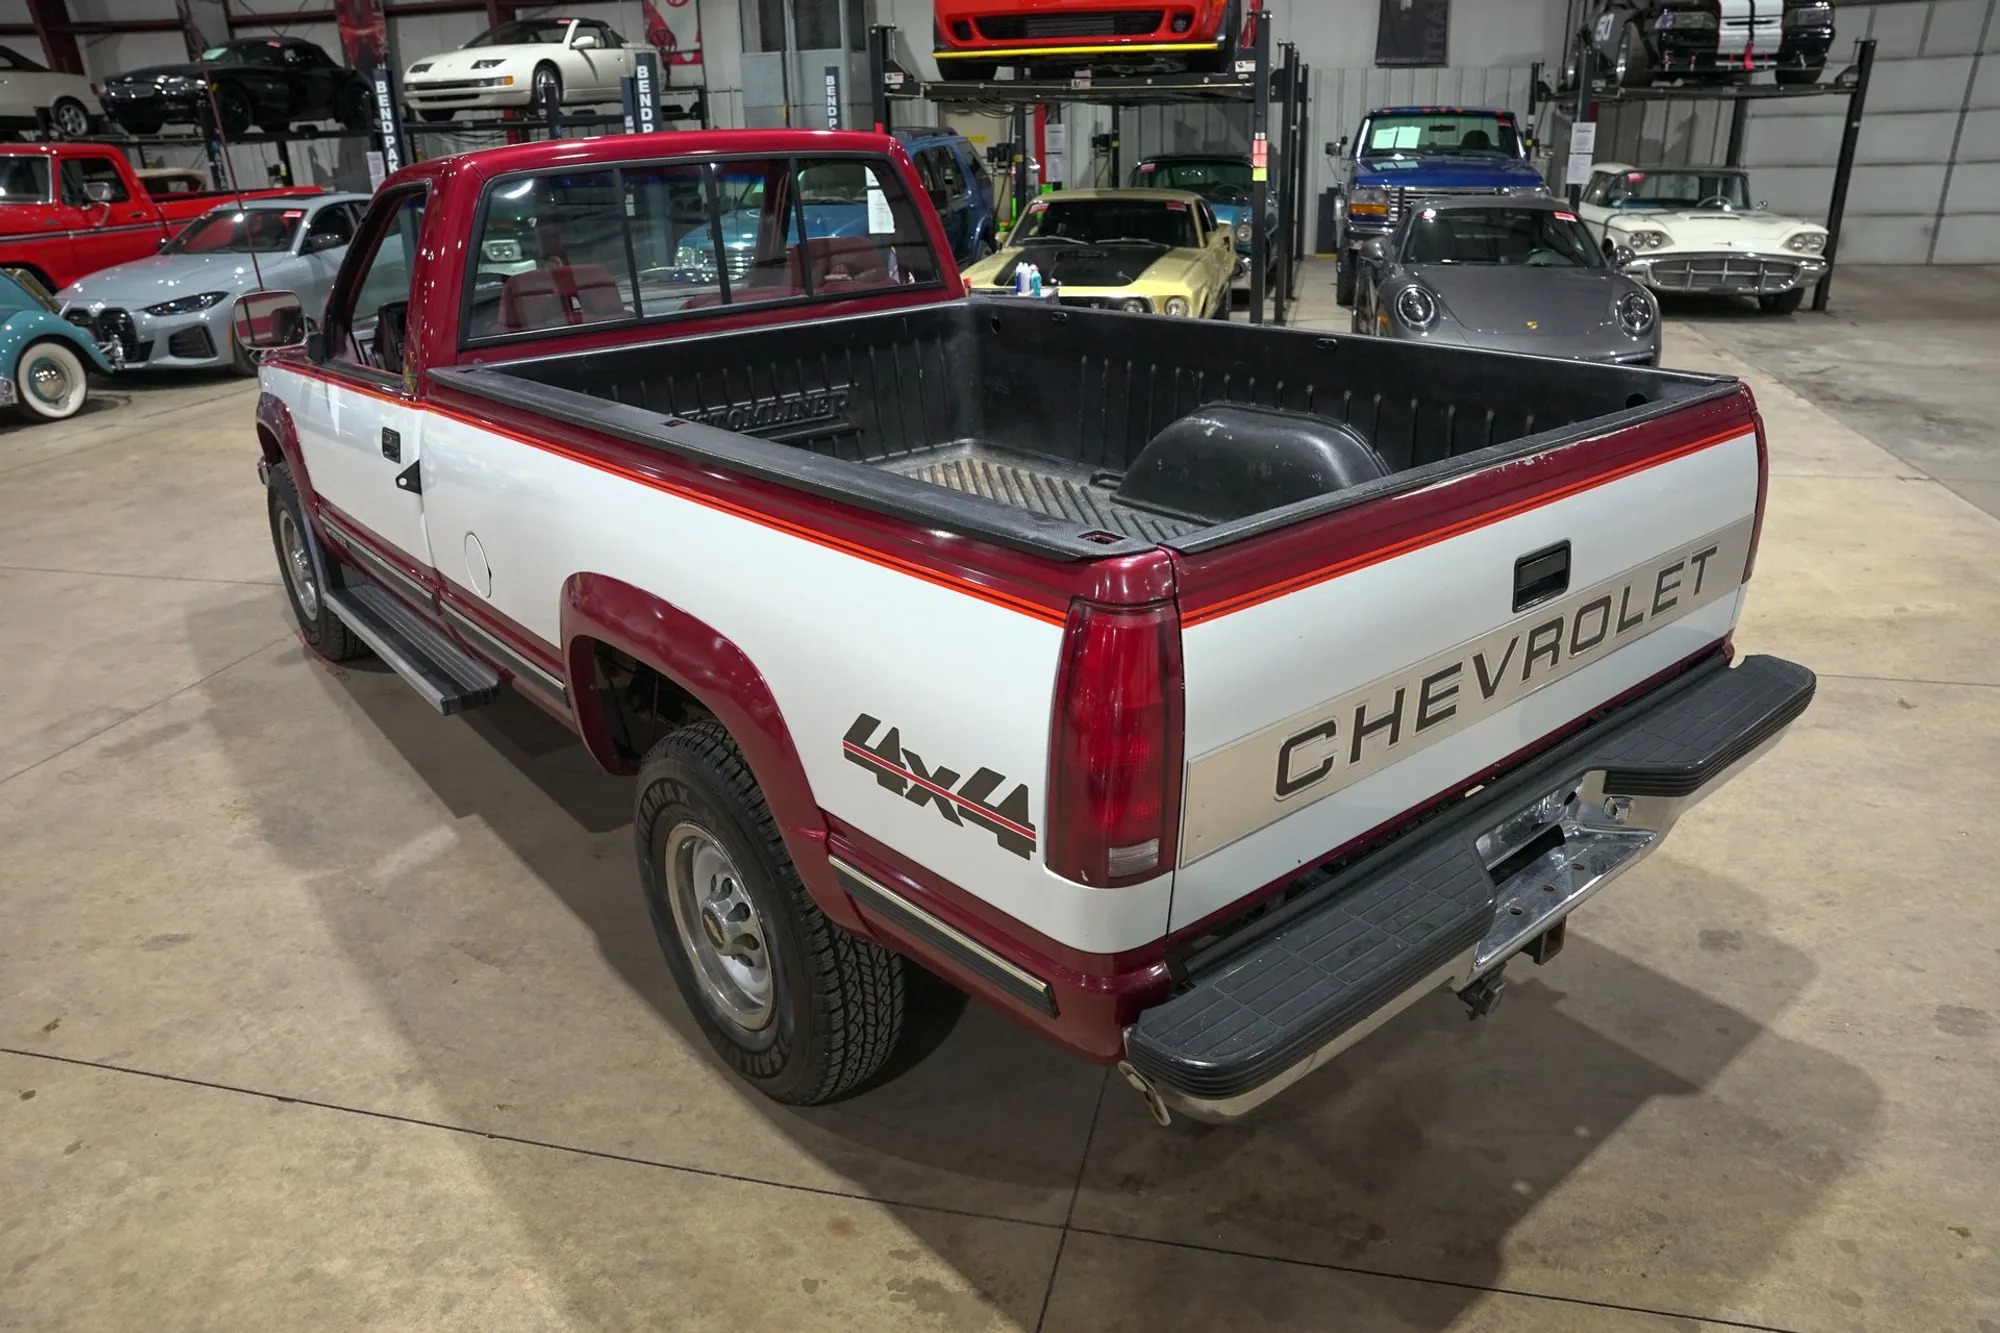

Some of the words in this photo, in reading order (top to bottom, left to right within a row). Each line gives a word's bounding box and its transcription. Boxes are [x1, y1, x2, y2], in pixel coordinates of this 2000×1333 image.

[375, 80, 399, 174] BENDPAK
[826, 75, 837, 130] BENDP
[1274, 544, 1718, 801] CHEVROLET
